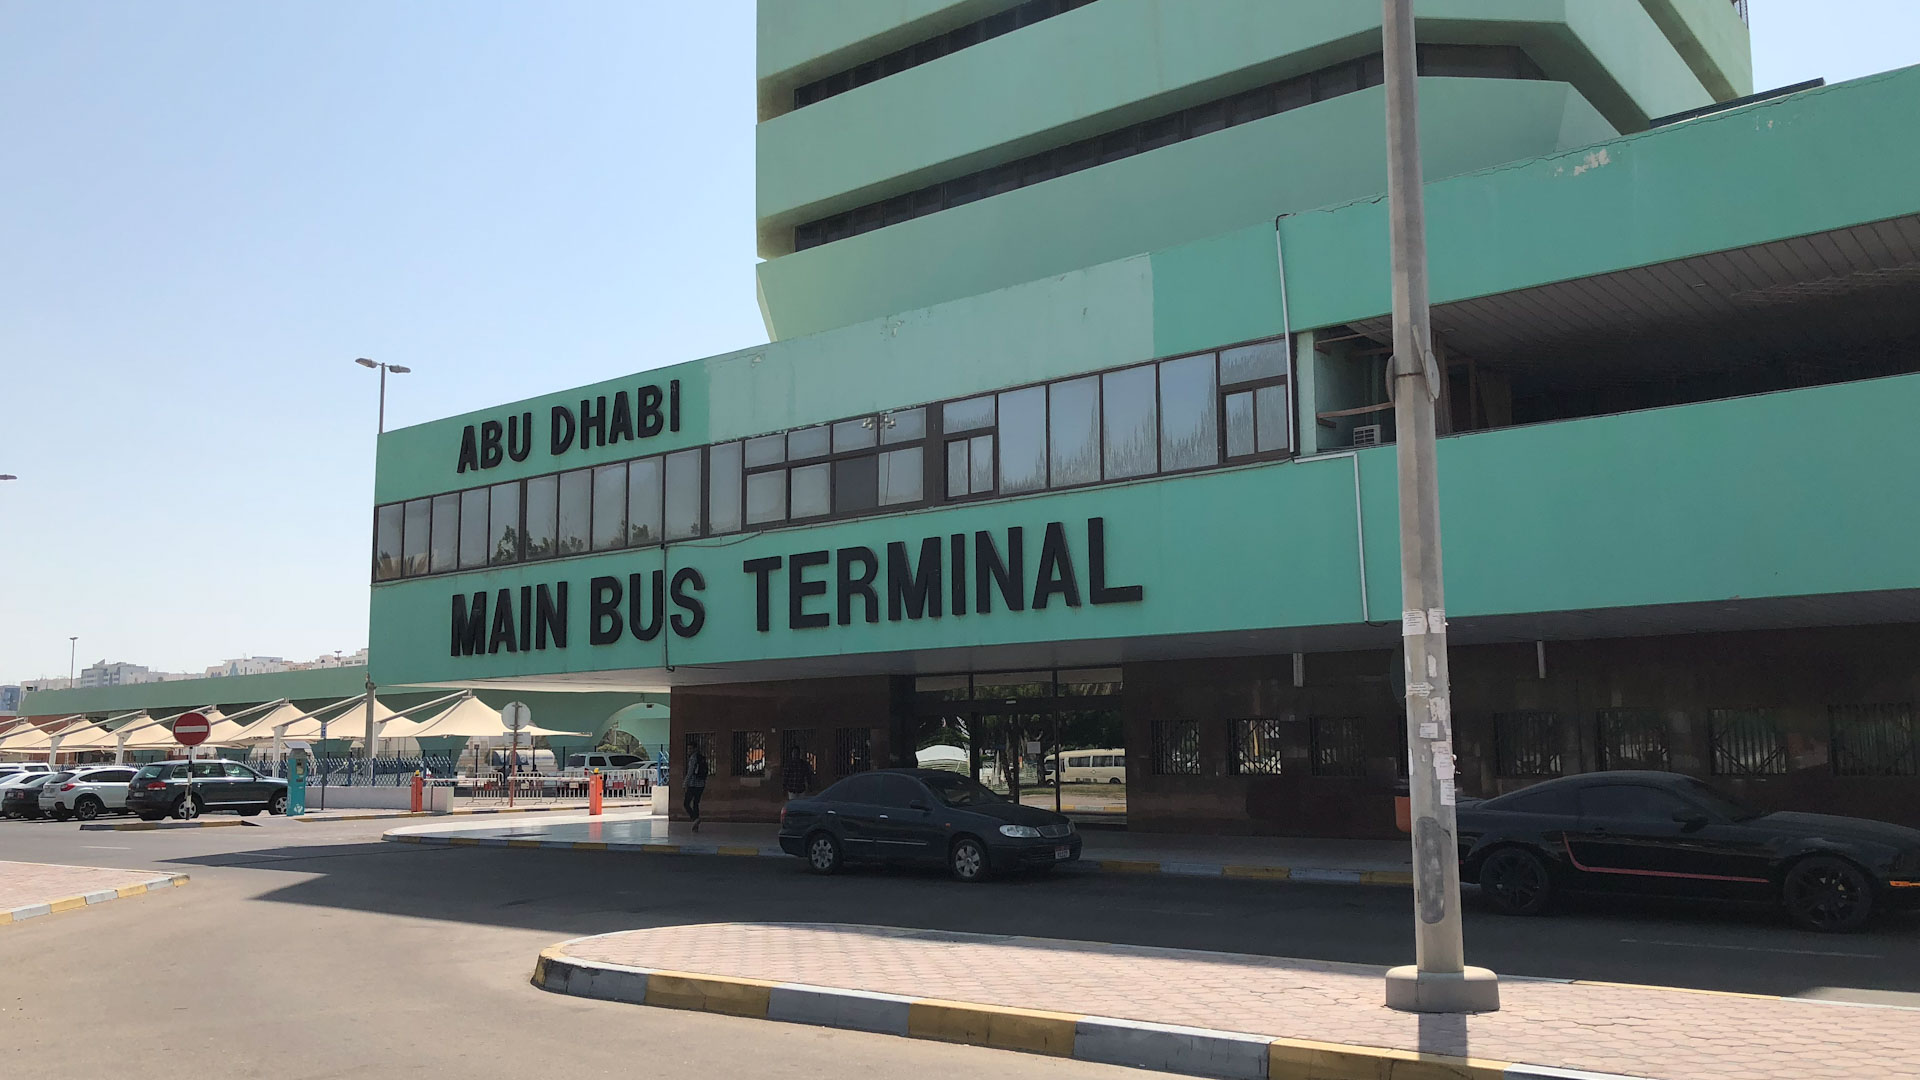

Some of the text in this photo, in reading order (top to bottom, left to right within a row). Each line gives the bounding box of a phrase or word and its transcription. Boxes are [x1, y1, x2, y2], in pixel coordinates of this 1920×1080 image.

[457, 379, 680, 473] ABU DHABI
[451, 517, 1143, 657] MAIN BUS TERMINAL
